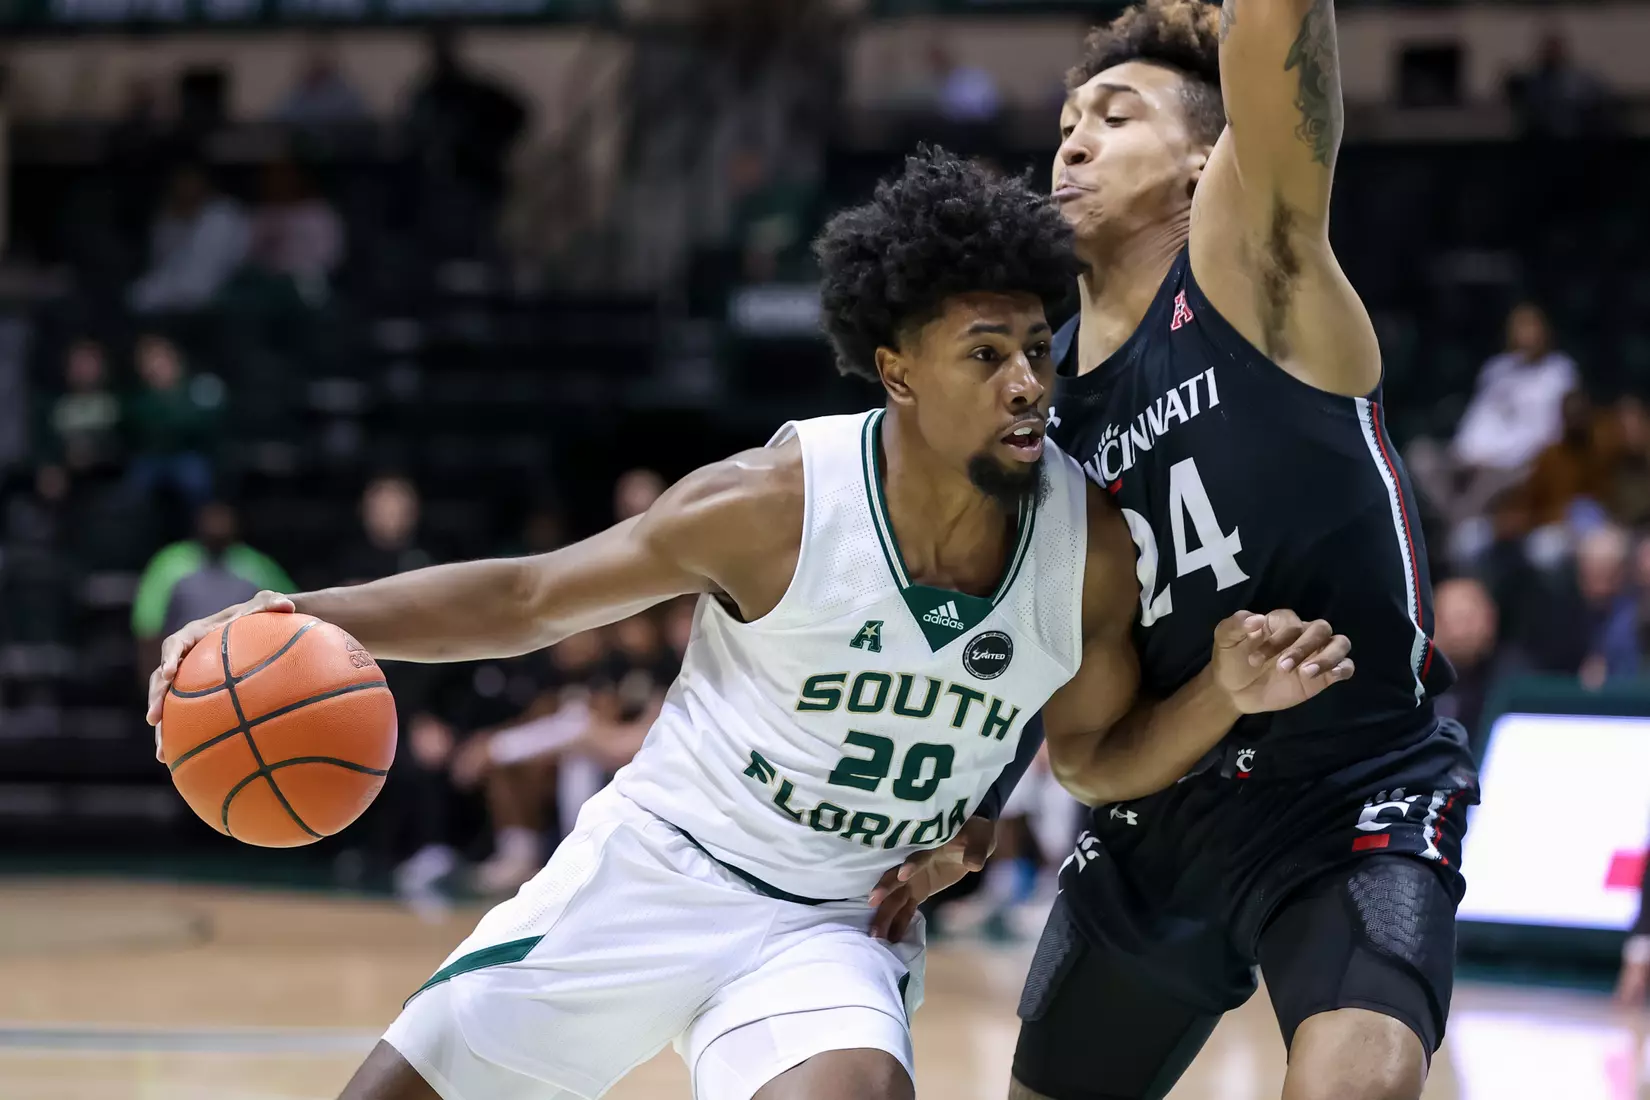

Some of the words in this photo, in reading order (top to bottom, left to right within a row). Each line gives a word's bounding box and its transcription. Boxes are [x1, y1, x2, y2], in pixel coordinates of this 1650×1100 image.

[1083, 366, 1220, 489] NCINNATI
[922, 613, 965, 631] adidas
[794, 669, 1022, 742] SOUTH
[742, 748, 971, 849] FLORIDA
[827, 729, 956, 802] 20
